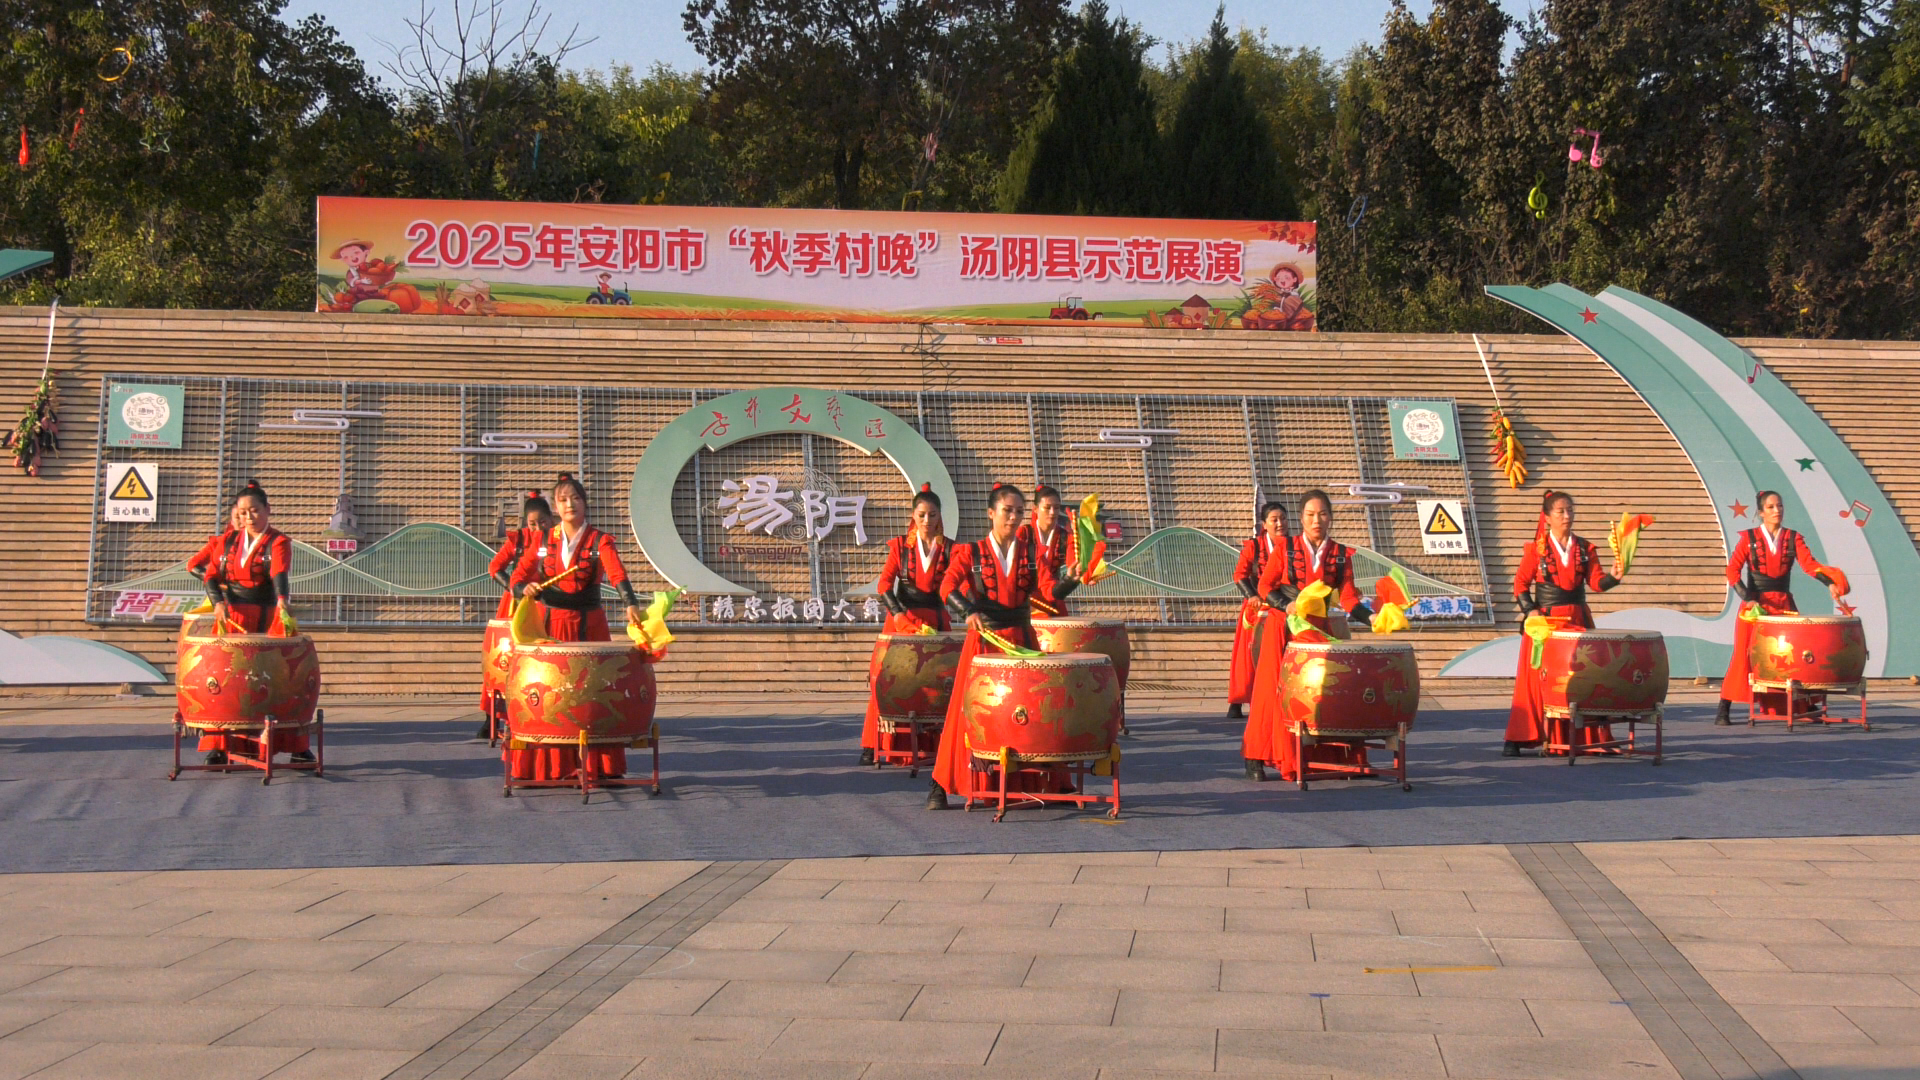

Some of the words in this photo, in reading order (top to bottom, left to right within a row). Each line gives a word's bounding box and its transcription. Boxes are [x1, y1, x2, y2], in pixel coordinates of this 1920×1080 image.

[406, 222, 706, 271] 2025年安阳市
[728, 228, 936, 275] “秋季村晚”
[959, 235, 1244, 283] 汤阴县示范展演
[112, 506, 151, 517] 当心触电
[1429, 539, 1463, 549] 当心触电
